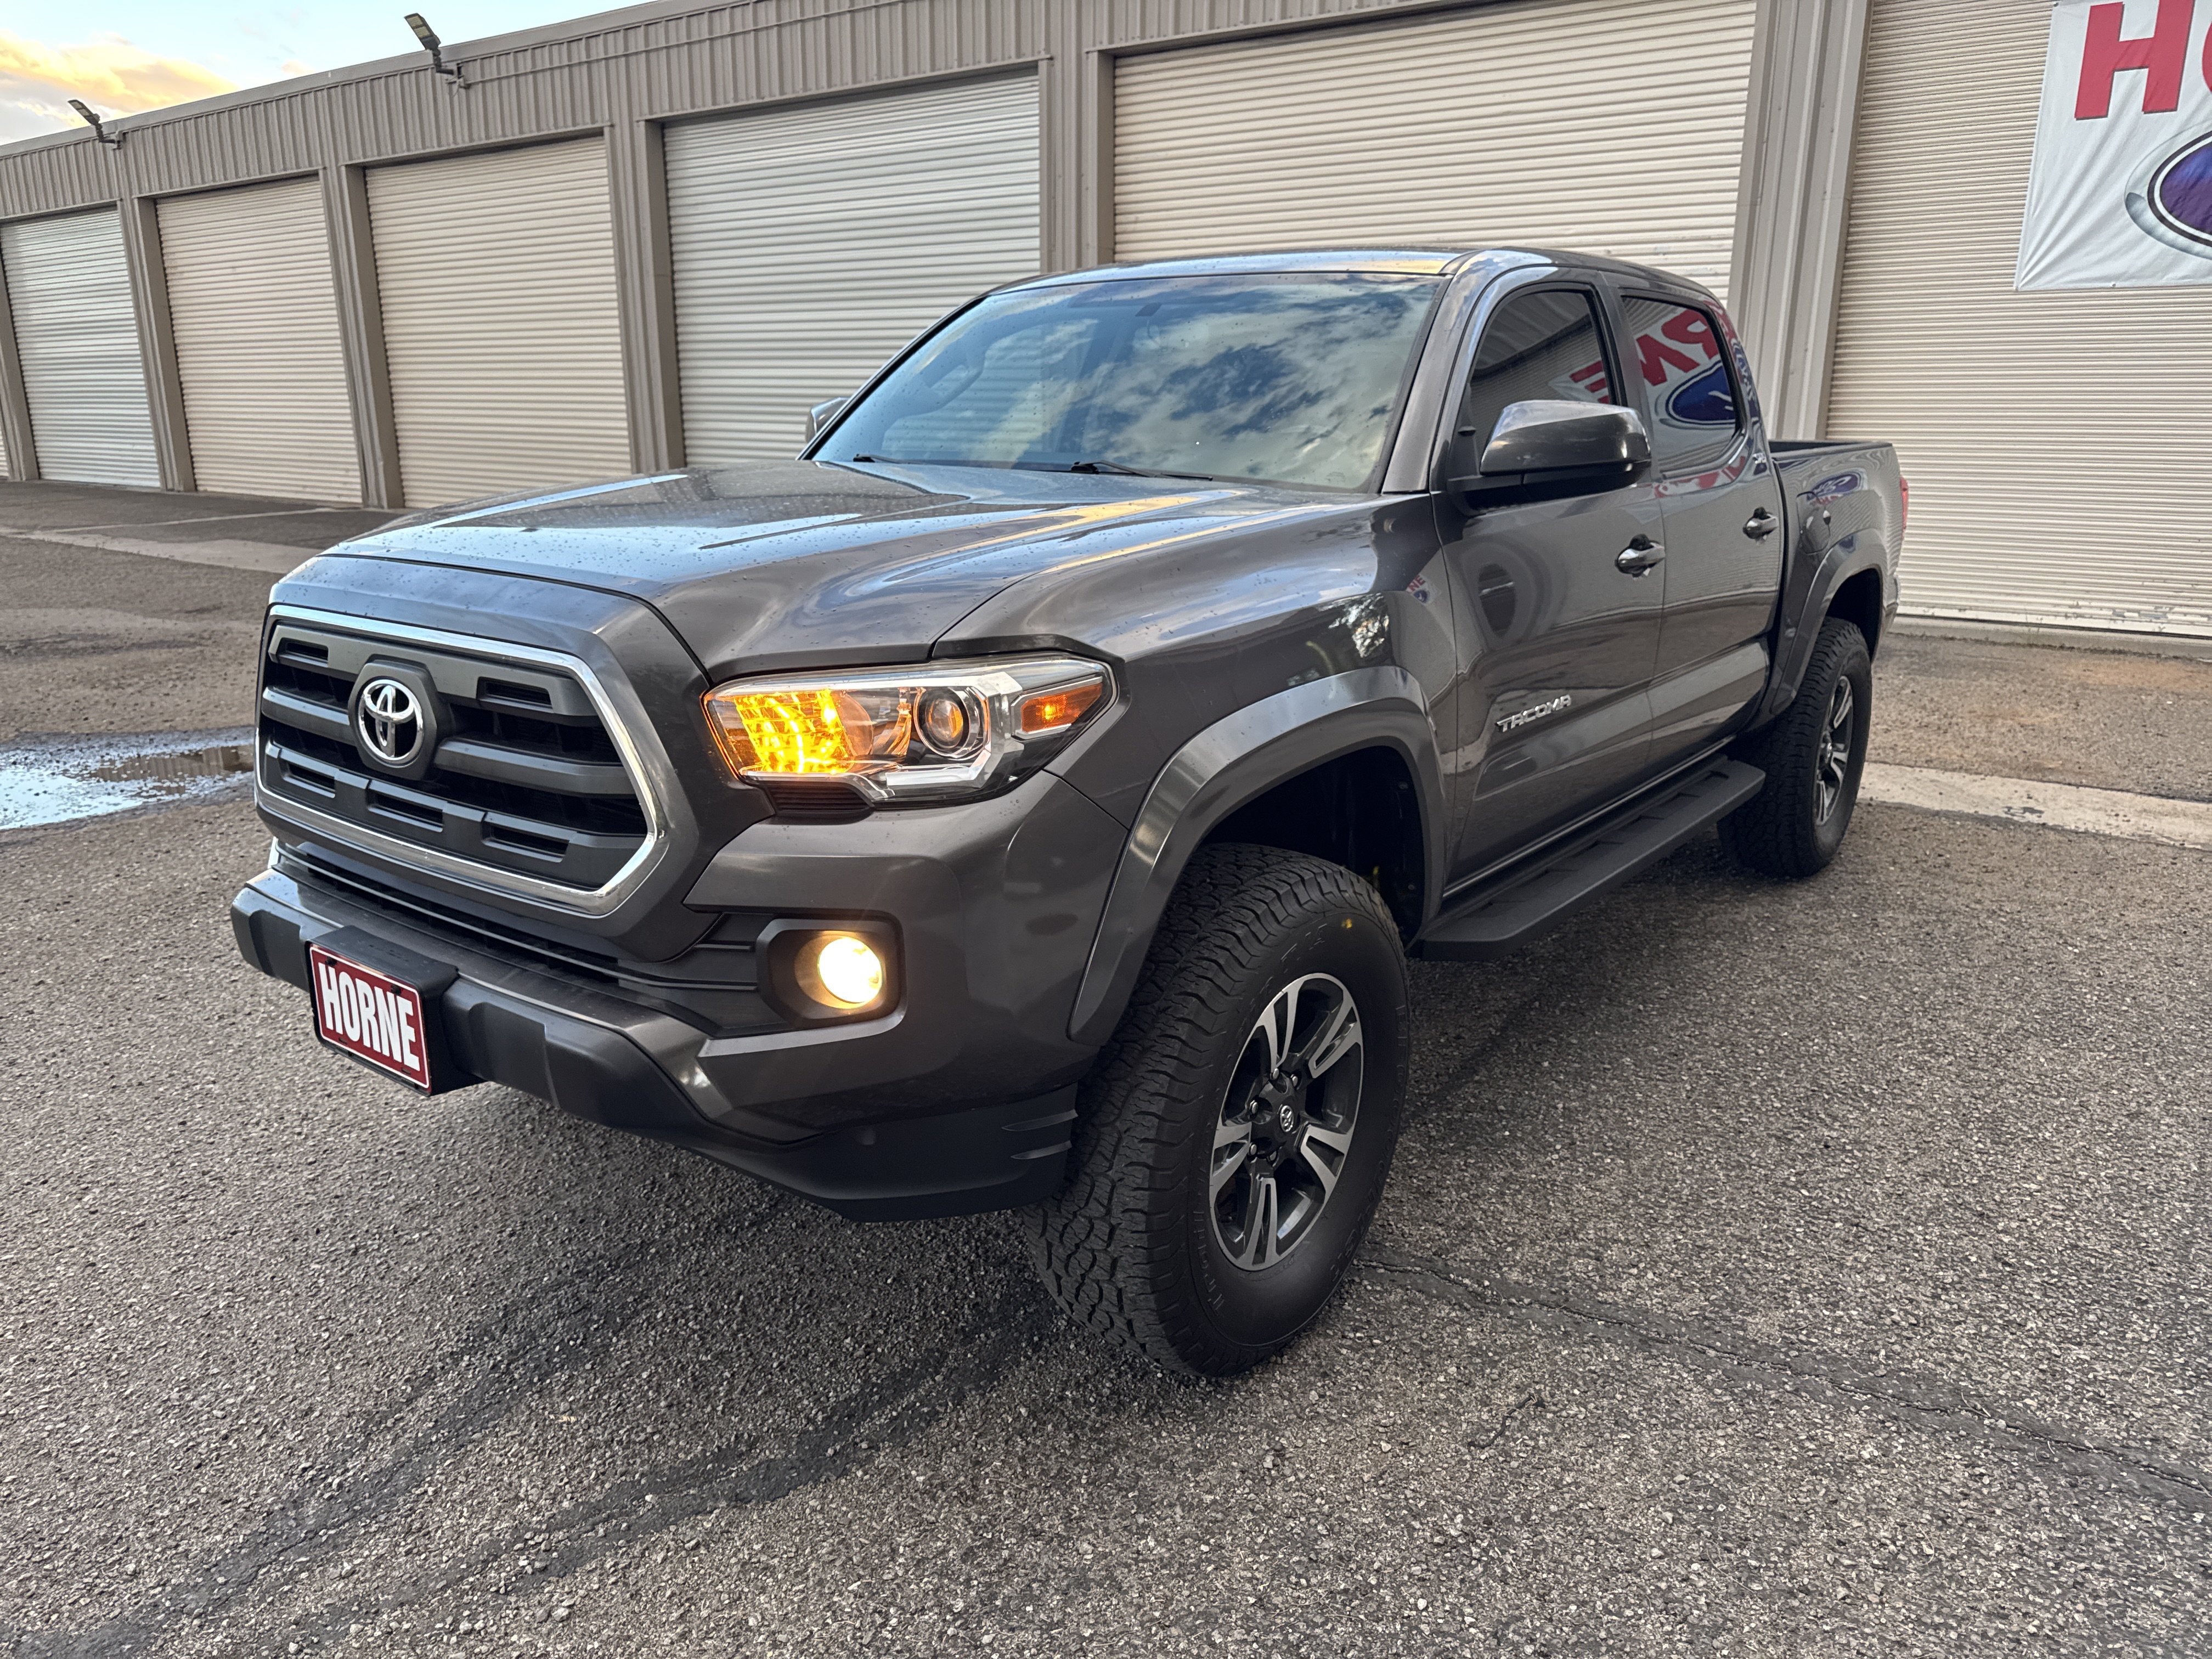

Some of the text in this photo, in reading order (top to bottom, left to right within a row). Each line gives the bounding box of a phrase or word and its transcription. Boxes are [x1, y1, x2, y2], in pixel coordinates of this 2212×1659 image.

[2074, 0, 2212, 121] H
[1495, 693, 1571, 732] TACOMA
[318, 962, 420, 1072] HORNE
